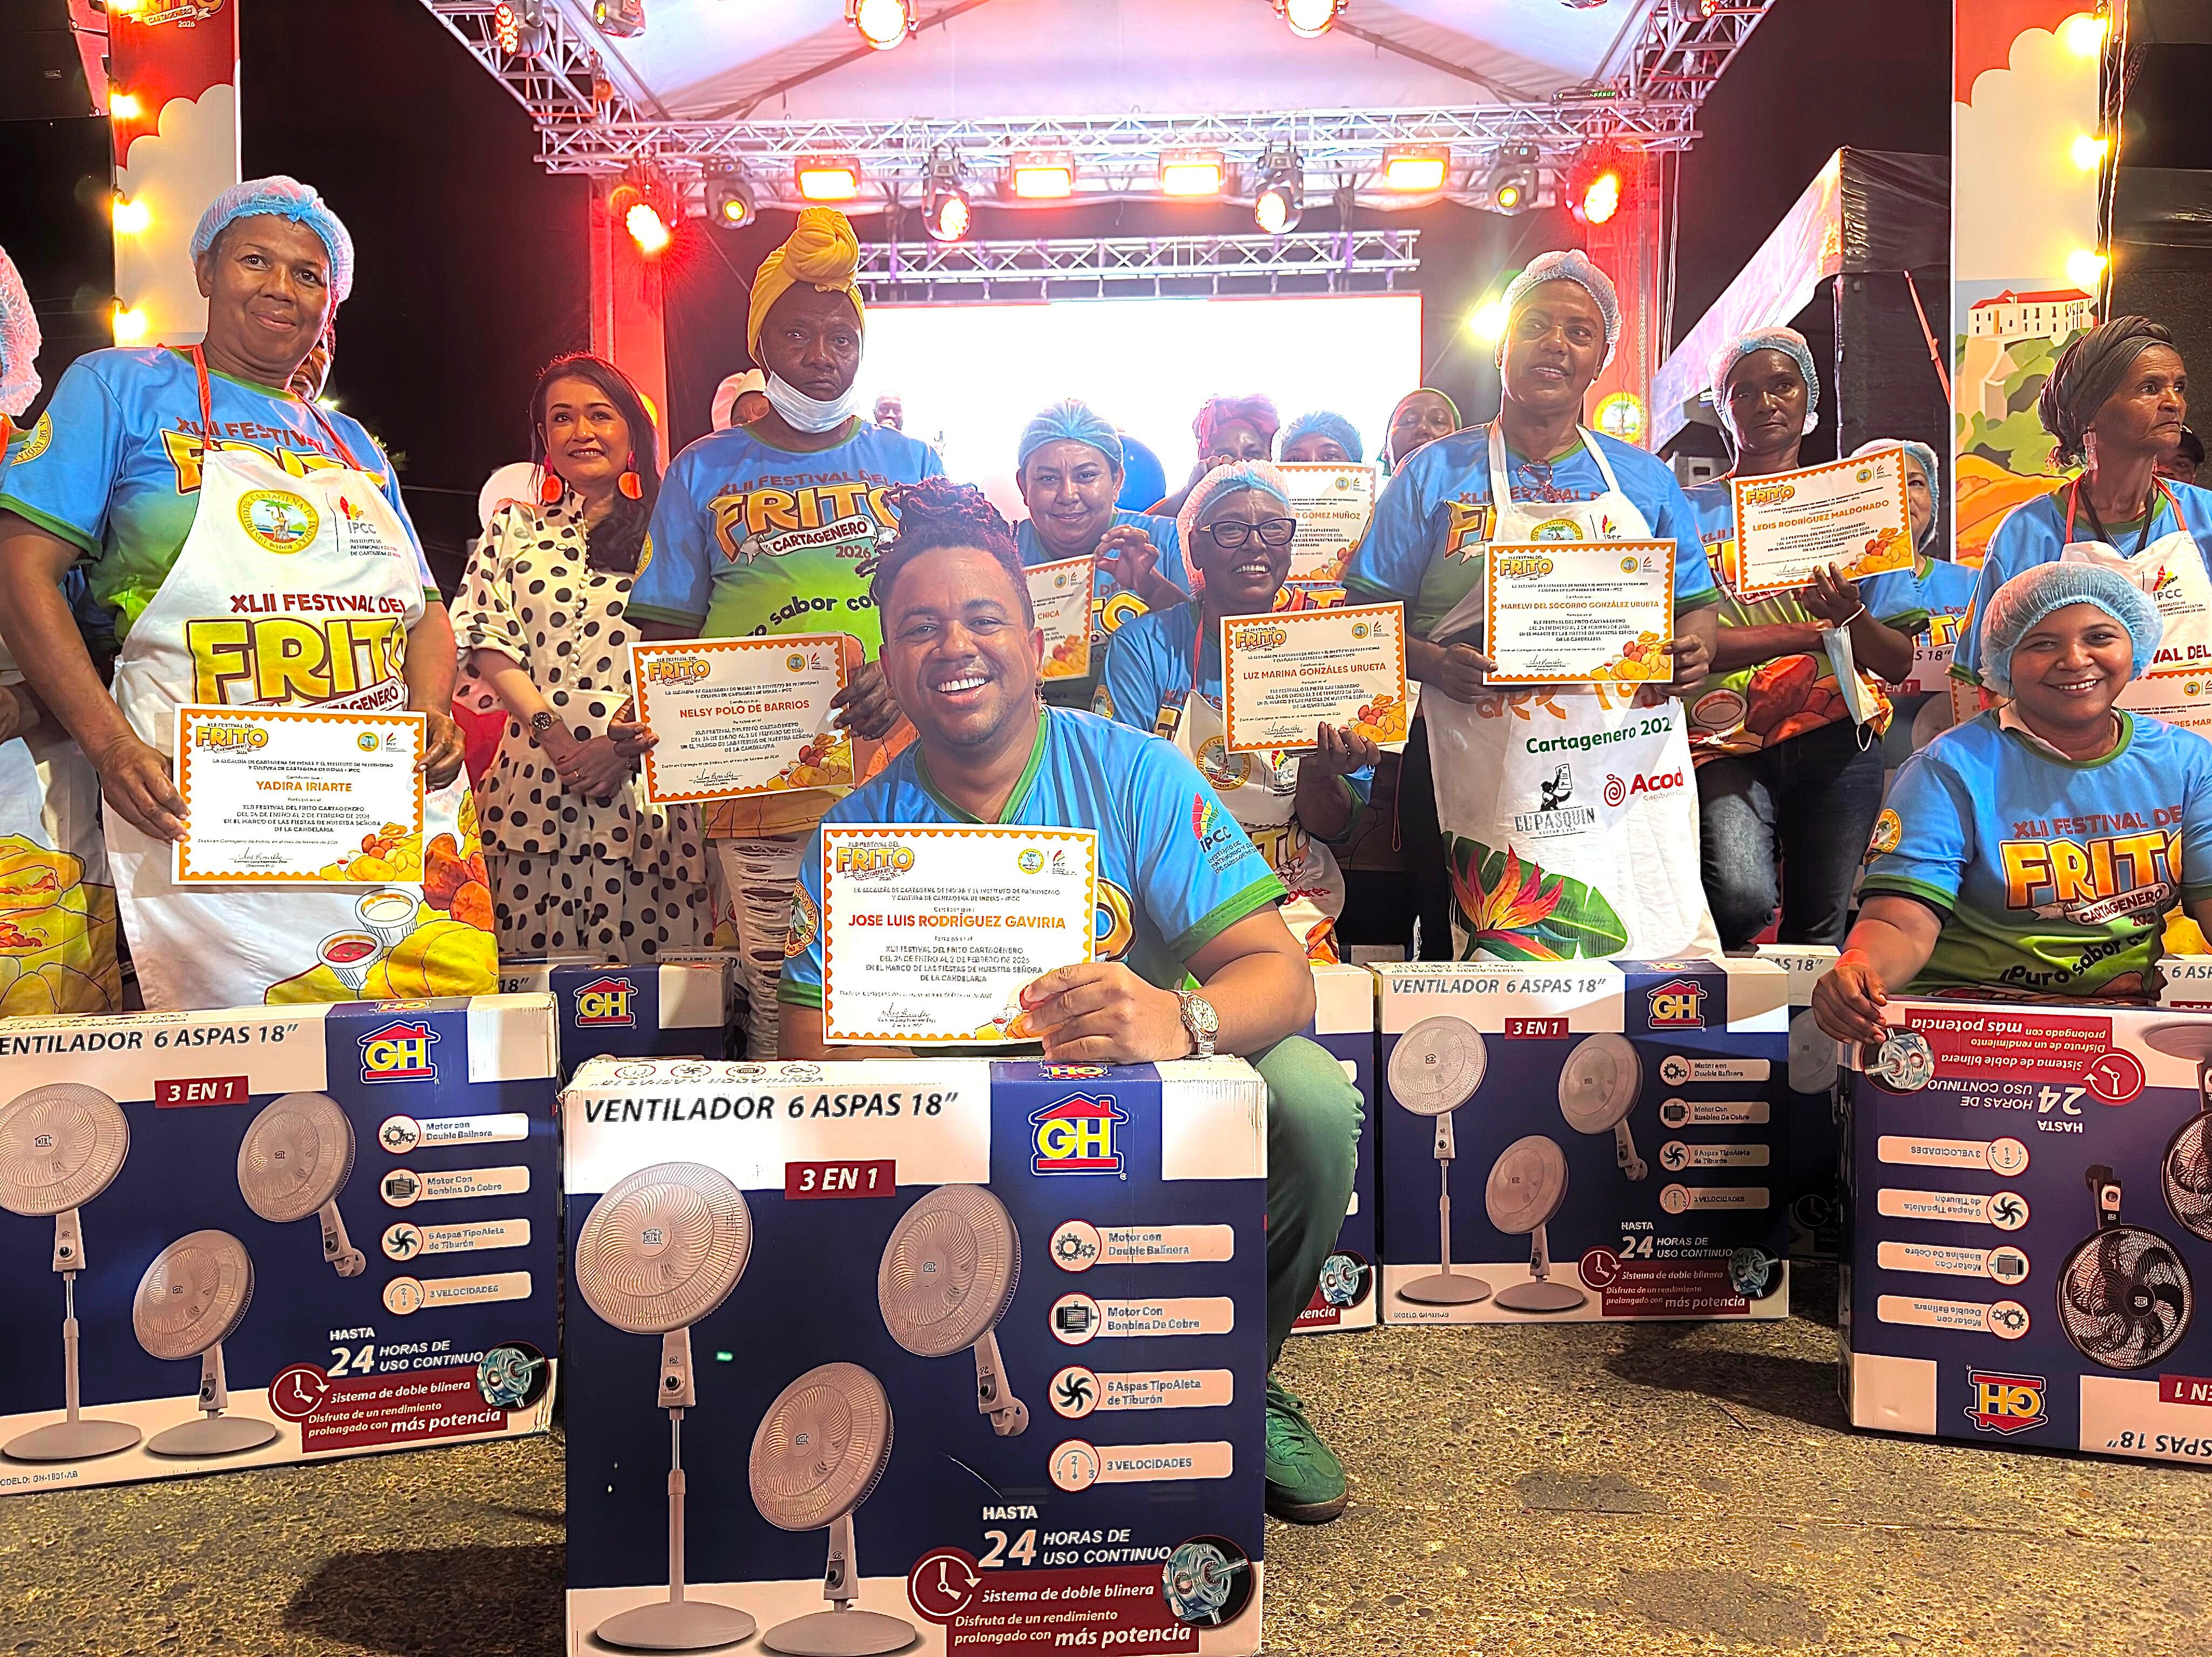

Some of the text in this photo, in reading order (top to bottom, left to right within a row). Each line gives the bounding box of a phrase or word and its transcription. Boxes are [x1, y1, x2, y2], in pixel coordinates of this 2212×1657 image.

[758, 471, 853, 487] FESTIVAL
[1753, 522, 1776, 531] LEDIS
[1779, 514, 1830, 529] RODRÍGUEZ
[1831, 500, 1889, 519] MALDONADO
[347, 522, 376, 534] IPCC
[773, 521, 867, 552] CARTAGENERO
[835, 546, 871, 559] 2026
[230, 594, 276, 613] XLII
[284, 594, 375, 613] FESTIVAL
[770, 597, 838, 625] sabor
[1589, 599, 1628, 608] GONZÁLEZ
[1037, 610, 1060, 619] CHICA
[2188, 645, 2211, 659] DEL
[649, 660, 710, 681] FRITO
[1262, 670, 1297, 678] MARINA
[1299, 665, 1348, 676] GONZÁLES
[1351, 663, 1386, 672] URUETA
[680, 700, 810, 718] NELSY POLO DE BARRIOS
[196, 726, 268, 747] FRITO
[1526, 717, 1672, 753] Cartagenero 202
[257, 781, 352, 792] YADIRA IRIARTE
[2013, 805, 2182, 838] XLII FESTIVAL DE
[1201, 826, 1232, 853] IPCC
[837, 847, 914, 873] FRITO
[2080, 888, 2163, 923] CARTAGENERO
[849, 913, 1065, 929] JOSE LUIS RODRÍGUEZ GAVIRIA
[1999, 941, 2122, 985] ¡Puro sabor
[1393, 978, 1606, 994] VENTILADOR 6 ASPAS 18"
[579, 993, 626, 1017] GH
[1653, 995, 1696, 1019] GH
[1513, 1022, 1557, 1035] 3 EN 1
[1912, 1019, 2022, 1035] más potencia
[0, 1023, 298, 1055] ENTILADOR 6 ASPAS 18"
[366, 1039, 426, 1071] GH
[167, 1082, 233, 1101] 3 EN 1
[1928, 1080, 2032, 1094] USO CONTINUO
[584, 1092, 959, 1123] VENTILADOR 6 ASPAS 18"
[1960, 1087, 2087, 1114] 24 HORAS DE
[2038, 1121, 2083, 1133] HASTA
[1038, 1119, 1111, 1158] GH
[800, 1168, 877, 1190] 3 EN 1
[1622, 1222, 1654, 1230] HASTA
[1108, 1233, 1139, 1242] Motor
[1108, 1247, 1145, 1255] Double
[1620, 1236, 1653, 1258] 24
[1657, 1238, 1692, 1246] HORAS
[1681, 1249, 1732, 1257] CONTINUO
[1666, 1295, 1745, 1309] más potencia
[1108, 1307, 1162, 1317] Motor Con
[1108, 1321, 1150, 1330] Bonbina
[1168, 1319, 1199, 1328] Cobre
[330, 1328, 375, 1341] HASTA
[327, 1341, 450, 1377] 24 HORAS DE
[380, 1352, 483, 1371] USO CONTINUO
[1108, 1382, 1114, 1391] 6
[1116, 1382, 1148, 1392] Aspas
[1107, 1395, 1162, 1404] de Tiburón
[1980, 1384, 2040, 1417] GH
[1107, 1458, 1192, 1470] 3 VELOCIDADES
[982, 1506, 1037, 1520] HASTA
[979, 1530, 1131, 1567] 24 HORAS DE
[1043, 1547, 1171, 1565] USO CONTINUO
[981, 1584, 1154, 1602] Sistema de doble blinera
[955, 1610, 1117, 1627] Disfruta de un rendimiento
[954, 1625, 1191, 1649] prolongado con más potencia
